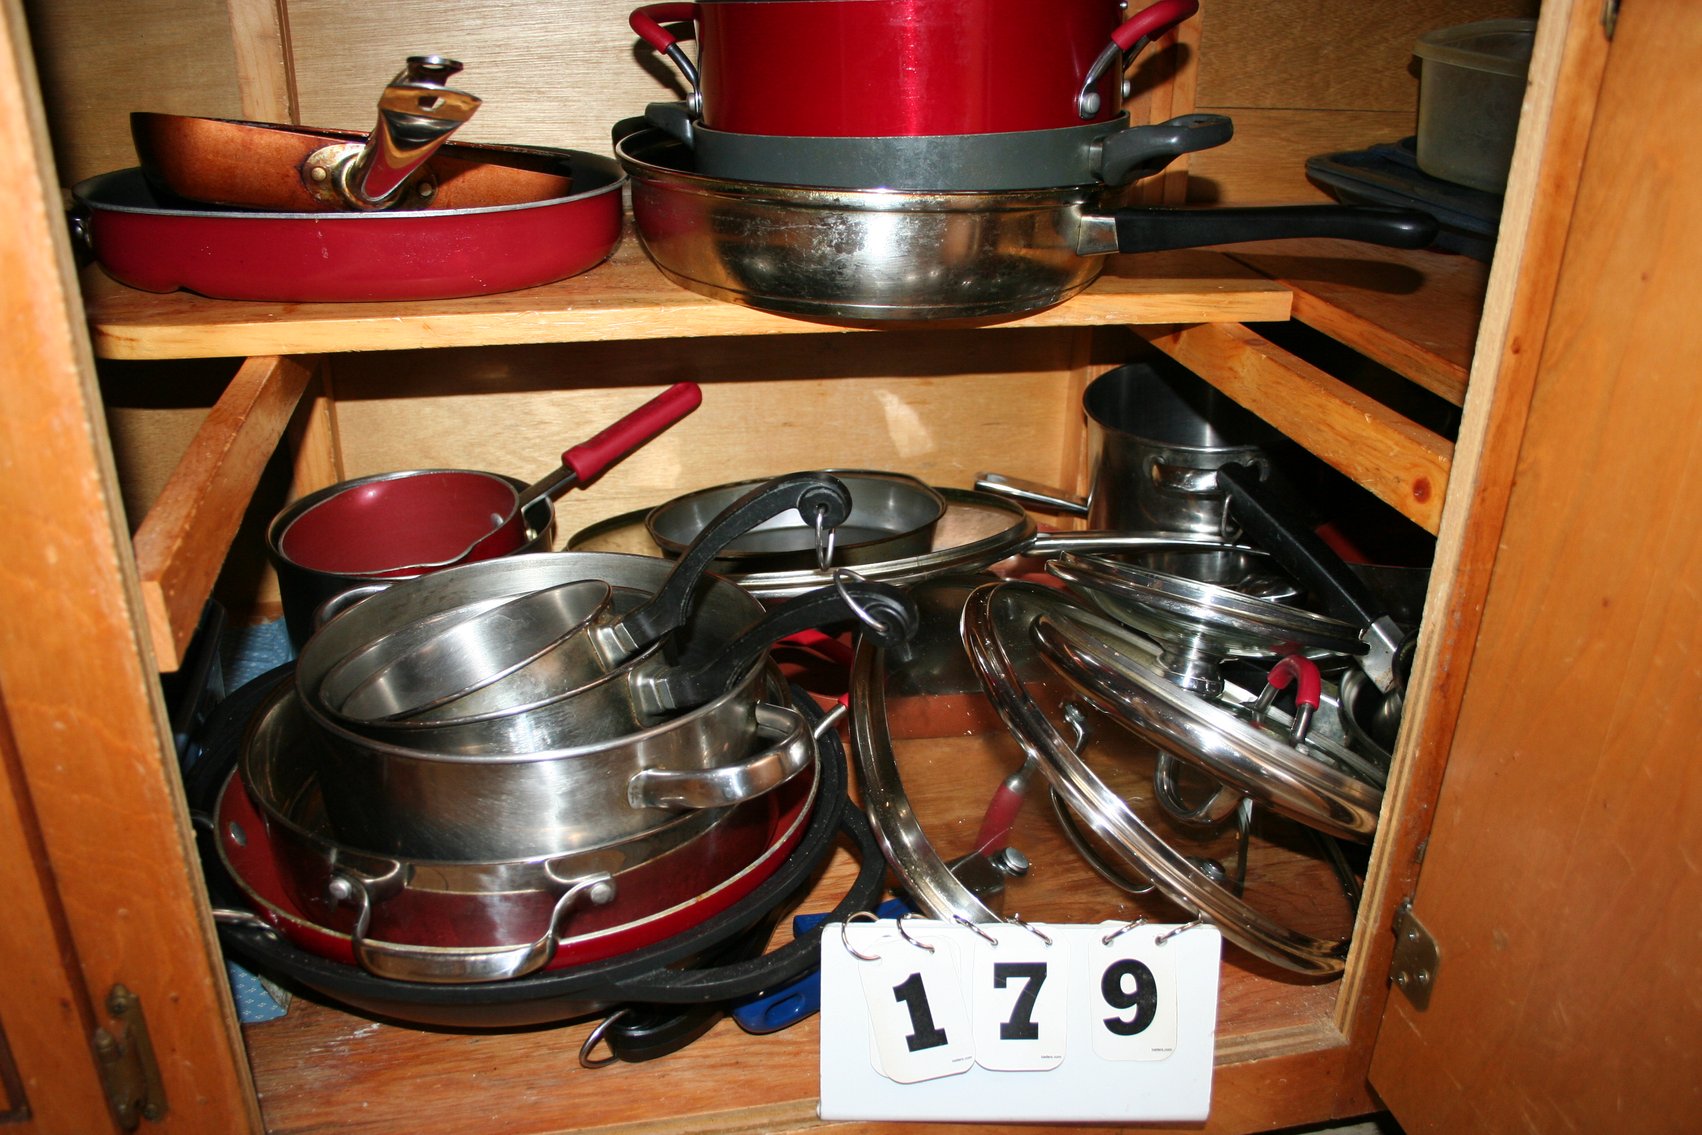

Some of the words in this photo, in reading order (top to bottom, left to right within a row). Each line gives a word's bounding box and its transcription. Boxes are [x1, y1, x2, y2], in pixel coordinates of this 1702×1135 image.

[892, 972, 949, 1053] 1
[993, 962, 1048, 1040] 7
[1100, 958, 1158, 1036] 9
